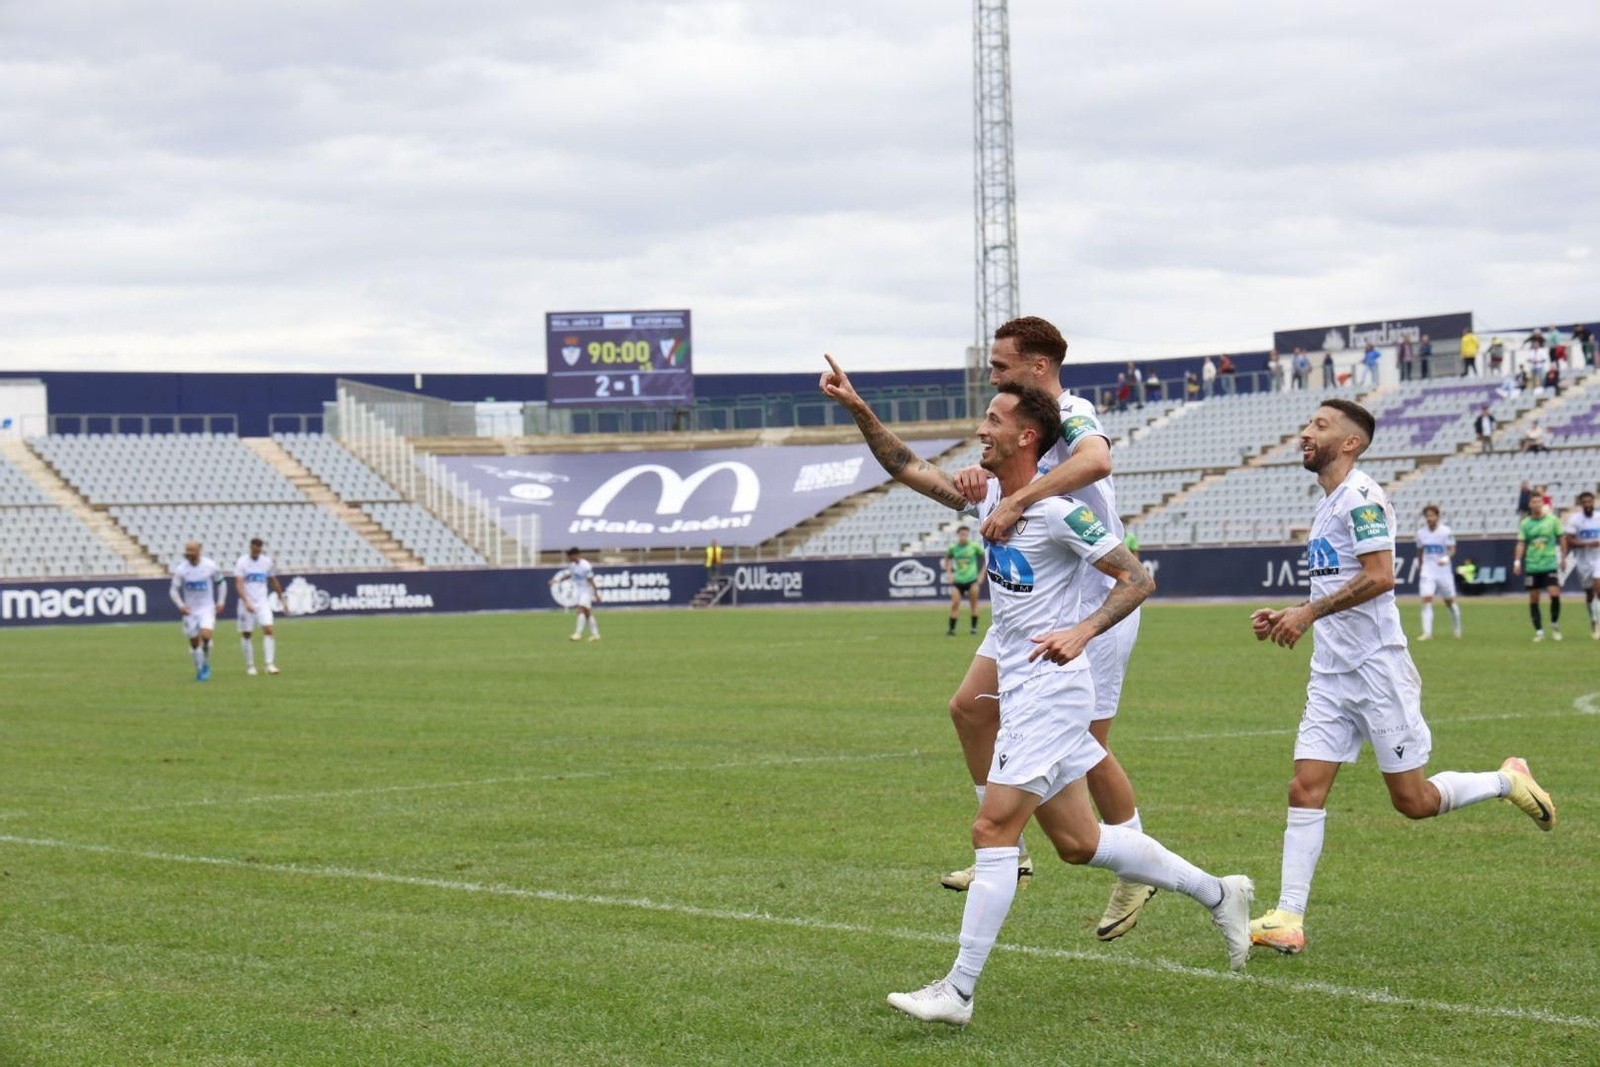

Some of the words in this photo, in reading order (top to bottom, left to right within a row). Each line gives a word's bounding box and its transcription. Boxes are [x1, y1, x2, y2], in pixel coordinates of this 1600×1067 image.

[587, 340, 650, 364] 90:00
[595, 375, 610, 397] 2
[630, 374, 640, 396] 1
[1262, 551, 1310, 587] JAÉ
[2, 586, 146, 619] macron
